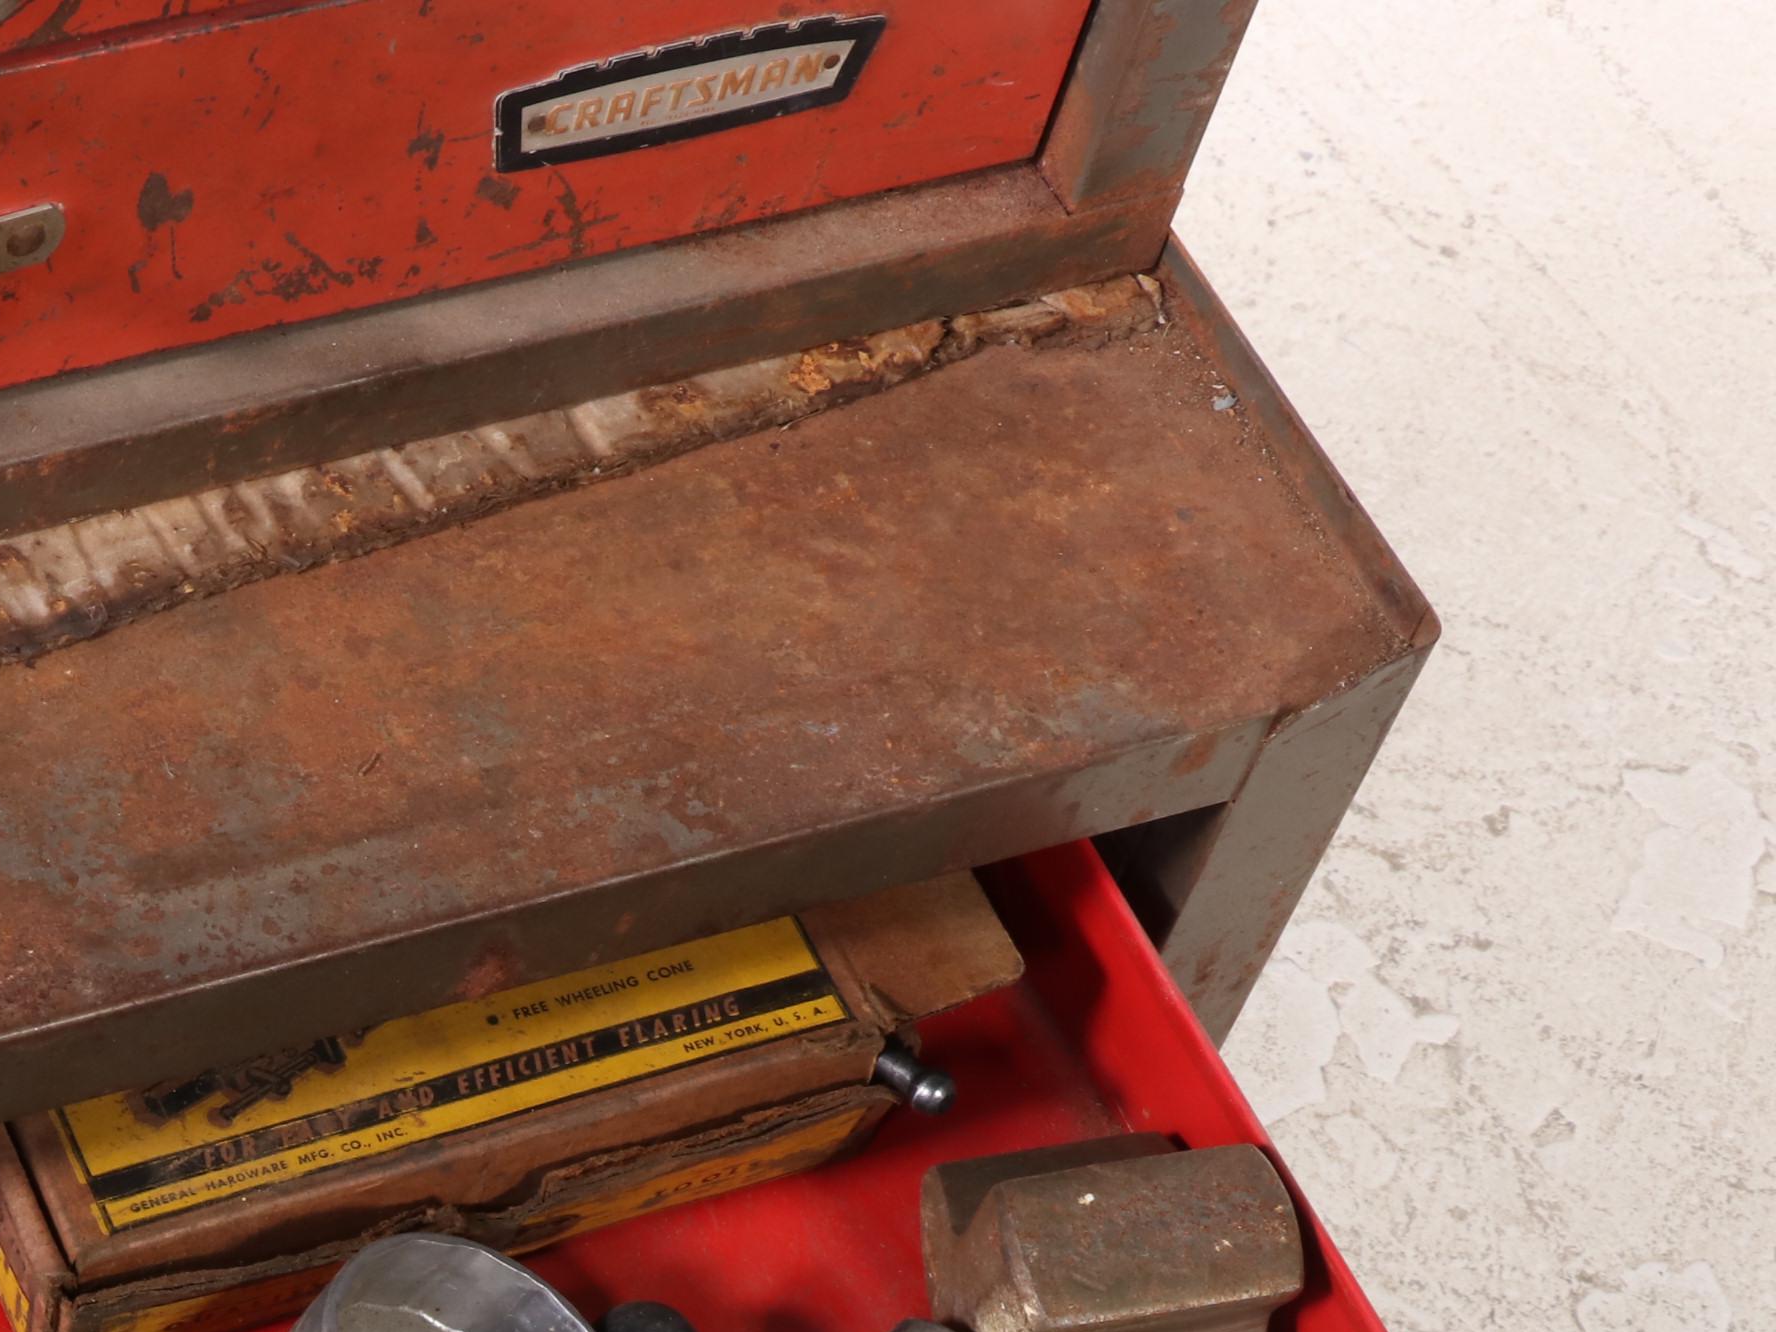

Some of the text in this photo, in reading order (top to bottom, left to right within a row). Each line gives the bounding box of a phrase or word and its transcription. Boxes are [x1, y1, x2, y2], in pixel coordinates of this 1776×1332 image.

[546, 51, 825, 136] CRAFTSMAN
[513, 959, 695, 1020] FREE WHEELING CONE
[129, 1186, 198, 1213] GENERAL
[205, 1161, 289, 1192] HARDWARE
[297, 1149, 335, 1167] MFG.
[375, 1126, 409, 1143] INC.
[683, 1034, 715, 1054] NEW
[723, 1022, 769, 1042] YORK,
[203, 1136, 258, 1170] FOR
[457, 1036, 596, 1096] EFFICIENT
[619, 995, 741, 1048] FLARING
